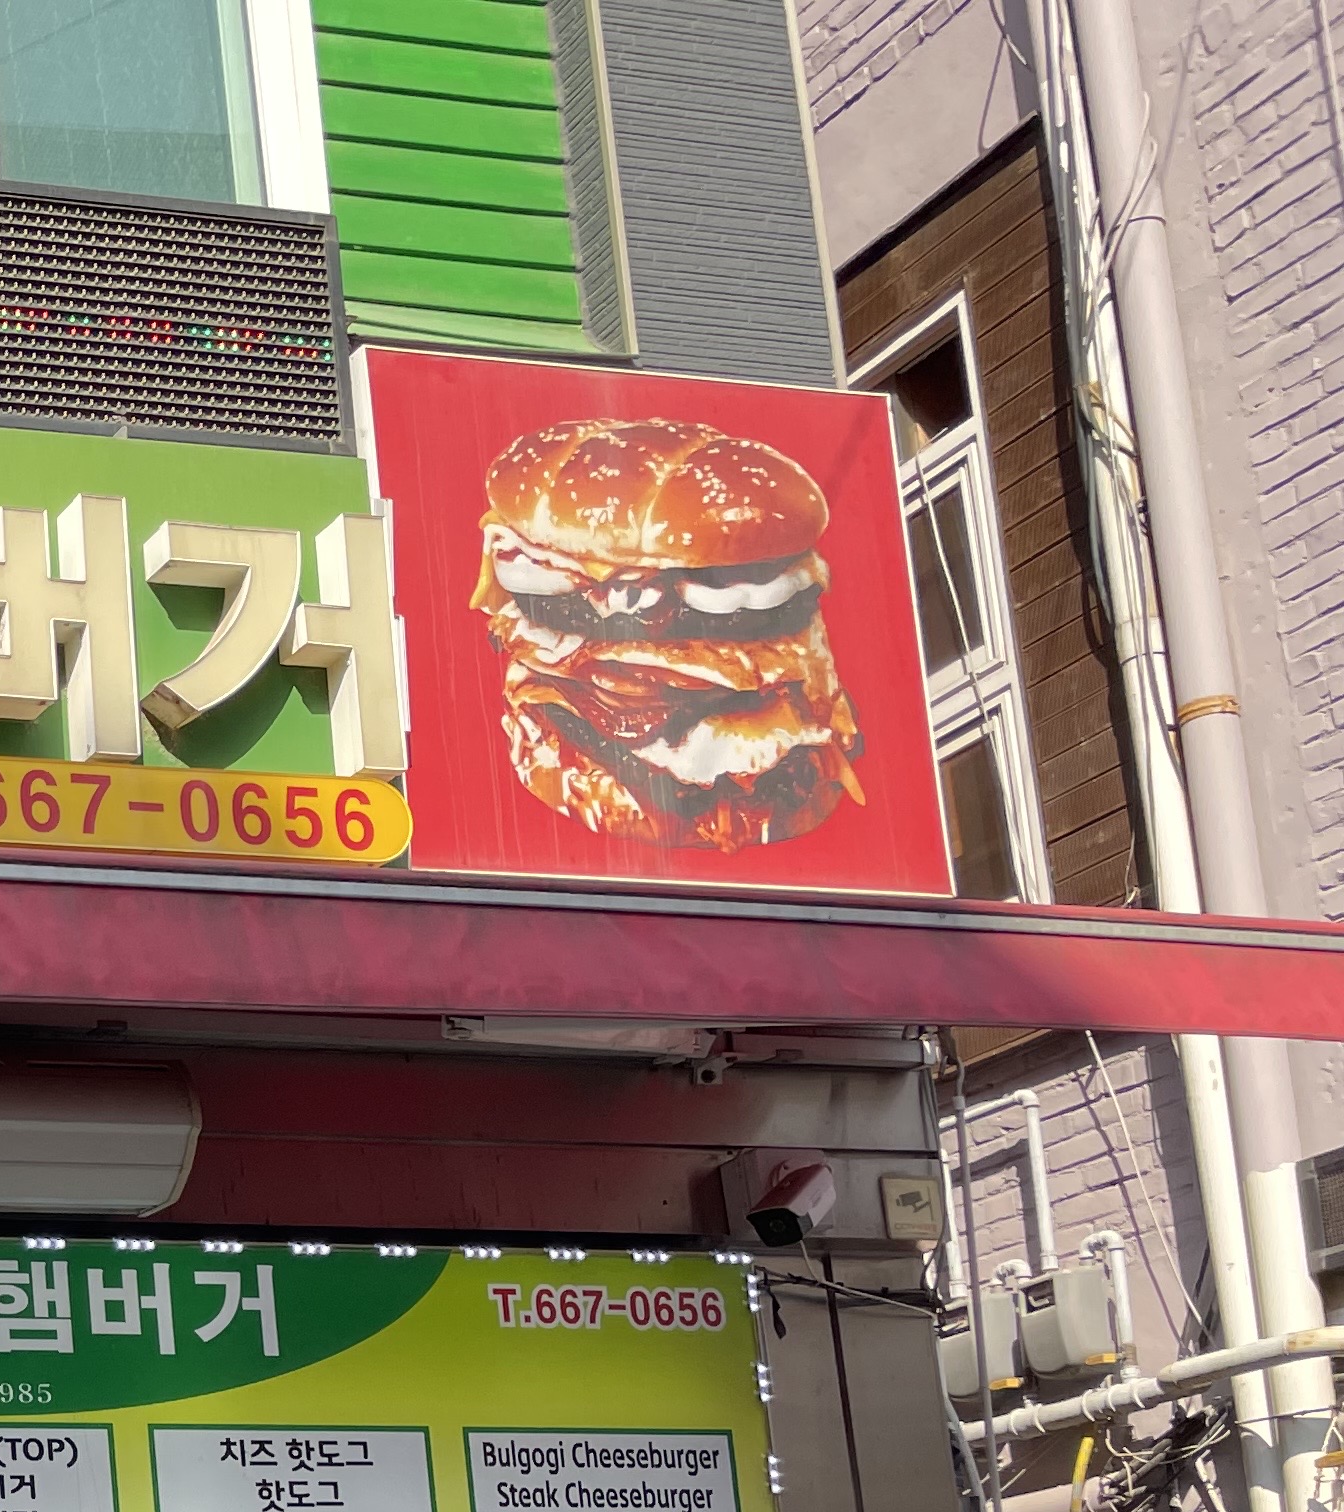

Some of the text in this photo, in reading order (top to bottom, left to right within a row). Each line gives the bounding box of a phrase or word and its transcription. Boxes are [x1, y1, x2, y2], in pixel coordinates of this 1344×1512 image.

[493, 1287, 722, 1328] T.667-0656
[220, 1438, 373, 1470] 치즈 핫도그
[482, 1440, 719, 1474] Bulgogi Cheeseburger
[256, 1480, 343, 1511] 핫도그
[497, 1481, 713, 1512] Steak Cheeseburger
